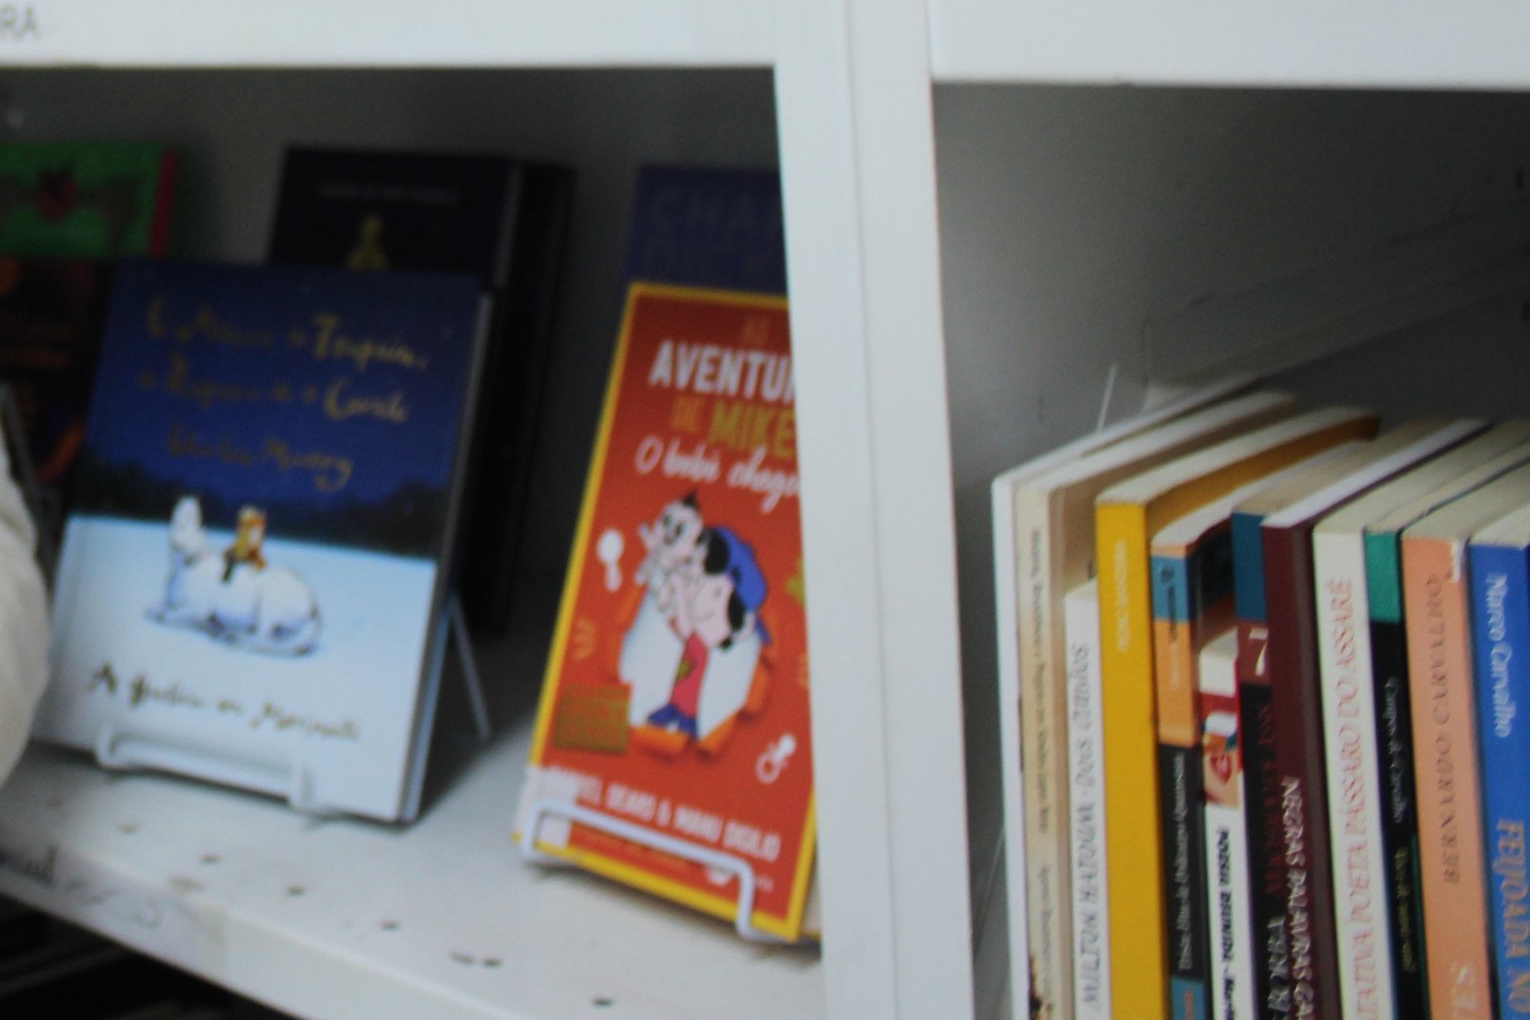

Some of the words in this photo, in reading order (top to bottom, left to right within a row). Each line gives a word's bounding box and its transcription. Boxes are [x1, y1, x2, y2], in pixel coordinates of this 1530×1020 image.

[1425, 574, 1451, 725] CARVALHO
[1280, 776, 1306, 867] NEGRAS
[1434, 734, 1460, 884] BERNARDO
[1080, 909, 1102, 1012] MILTON
